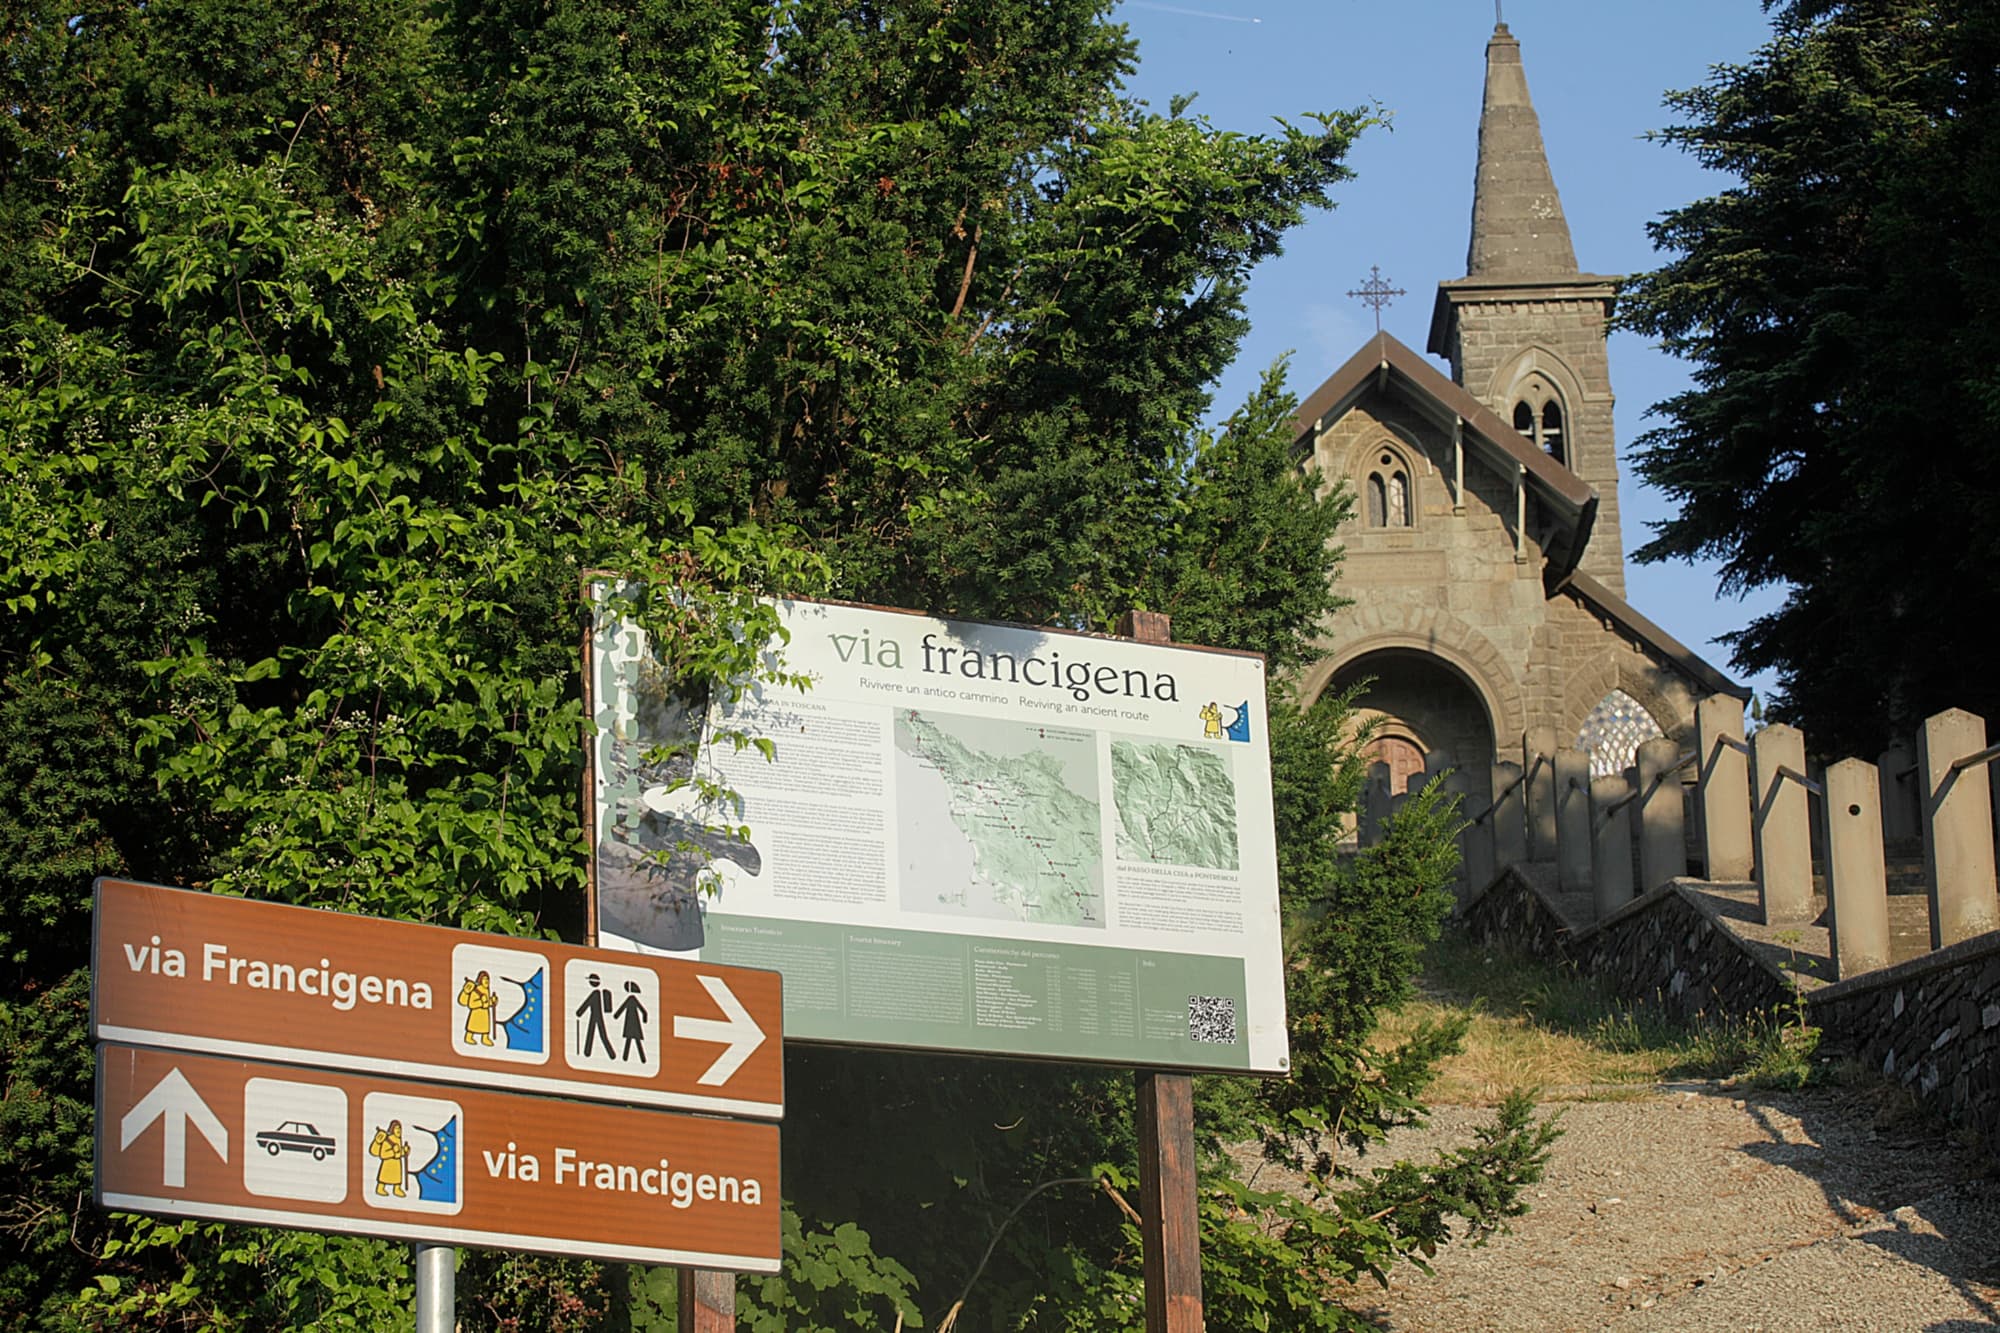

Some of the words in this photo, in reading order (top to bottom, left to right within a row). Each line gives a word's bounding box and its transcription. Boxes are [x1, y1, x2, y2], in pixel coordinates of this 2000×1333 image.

[828, 628, 904, 669] via
[920, 634, 1179, 703] francigena
[791, 702, 827, 712] TOSCANA
[860, 677, 903, 693] Rivivere
[906, 684, 921, 695] un
[924, 685, 956, 699] antico
[959, 689, 1009, 705] cammino
[1019, 695, 1062, 713] Reviving
[1065, 703, 1079, 714] an
[1081, 703, 1117, 718] ancient
[1120, 709, 1150, 721] route
[124, 935, 186, 978] via
[203, 943, 433, 1011] Francigena
[482, 1141, 540, 1182] via
[554, 1147, 762, 1209] Francigena
